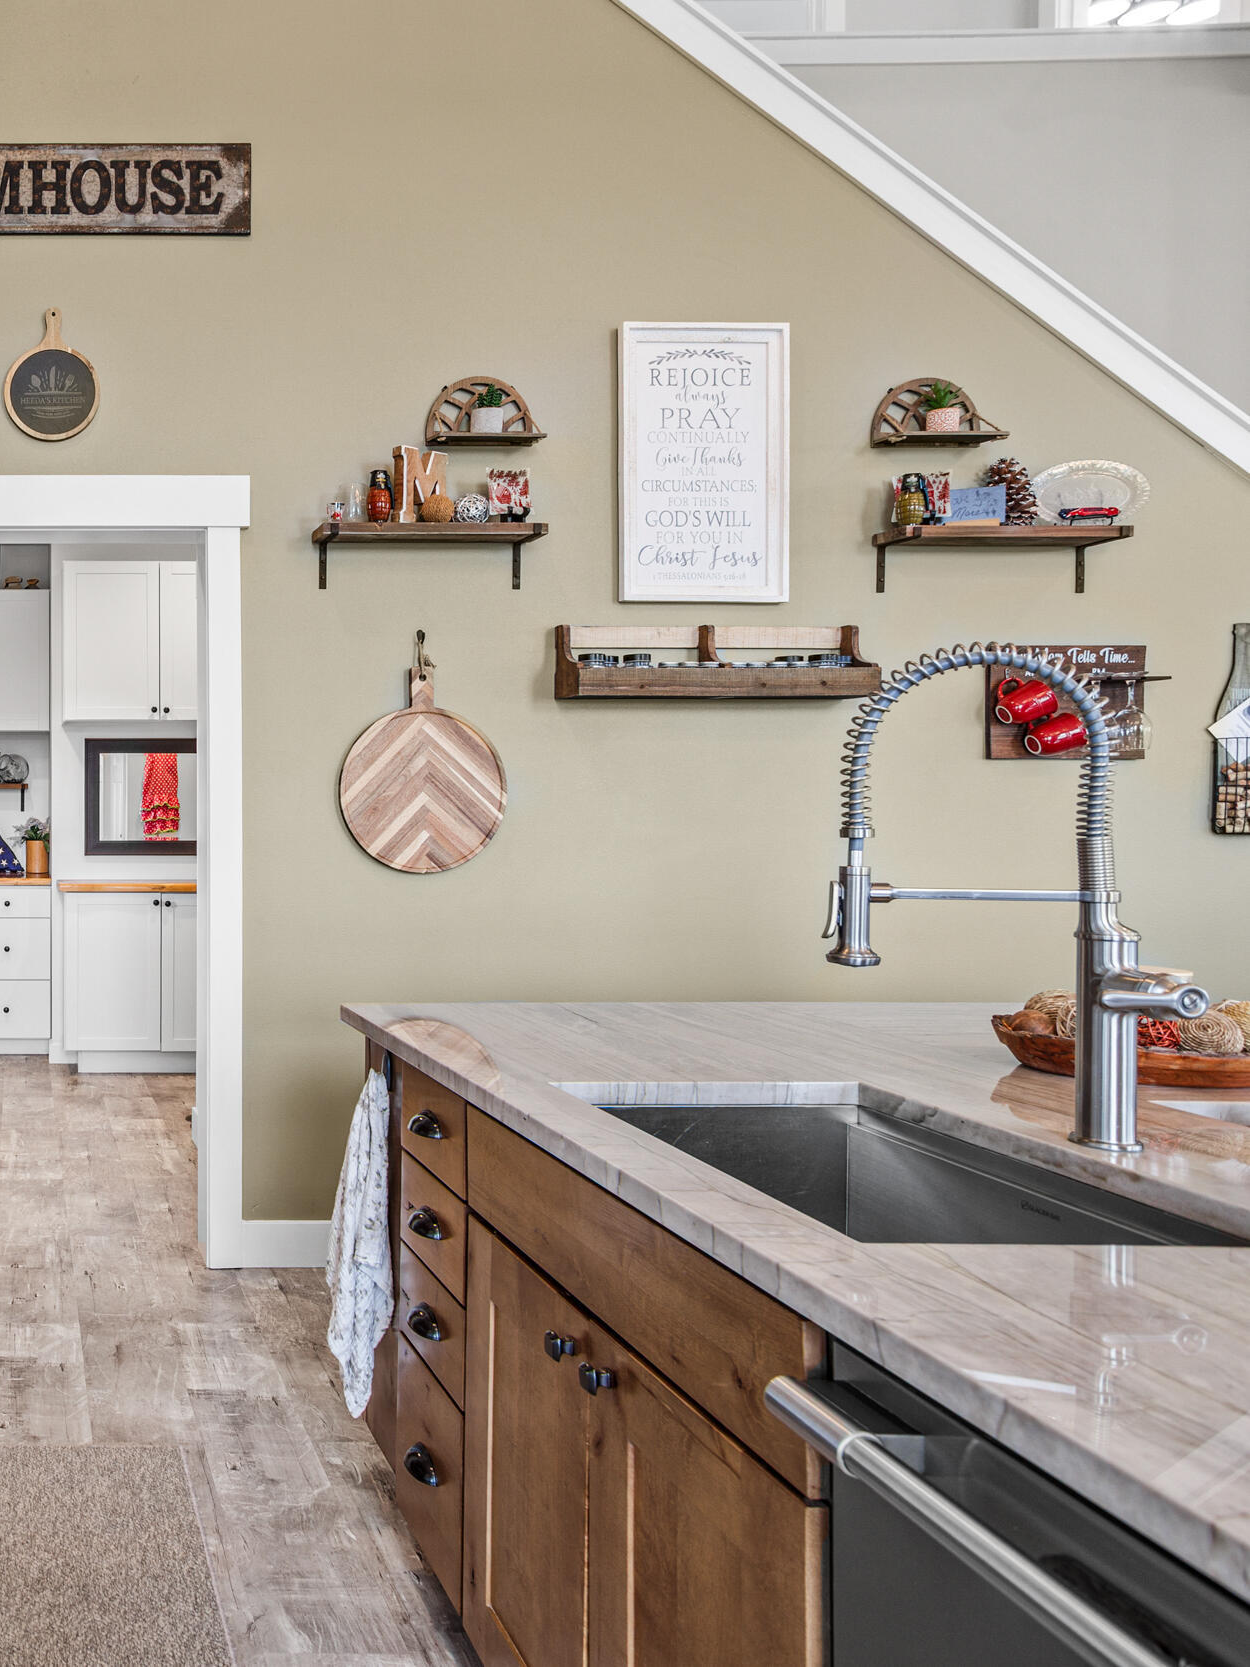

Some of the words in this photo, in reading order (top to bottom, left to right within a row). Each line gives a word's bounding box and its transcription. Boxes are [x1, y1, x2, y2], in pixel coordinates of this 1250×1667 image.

[649, 368, 751, 388] REJOICE
[675, 385, 727, 408] always
[660, 408, 741, 429] PRAY
[647, 431, 750, 443] CONTINUALLY
[656, 447, 687, 468] Give
[687, 446, 745, 468] Thanks
[681, 467, 693, 476] IN
[696, 467, 717, 476] ALL
[641, 479, 757, 493] CIRCUMSTANCES;
[668, 497, 689, 506] FOR
[693, 497, 717, 506] THIS
[720, 497, 730, 506] IS
[645, 510, 701, 527] GOD'S
[705, 510, 751, 527] WILL
[656, 531, 684, 544] FOR
[690, 531, 722, 544] YOU
[727, 531, 743, 544] IN
[638, 545, 707, 566] Christ
[710, 544, 763, 570] Jesus
[1067, 647, 1096, 664] Tells
[1100, 647, 1135, 664] Time...
